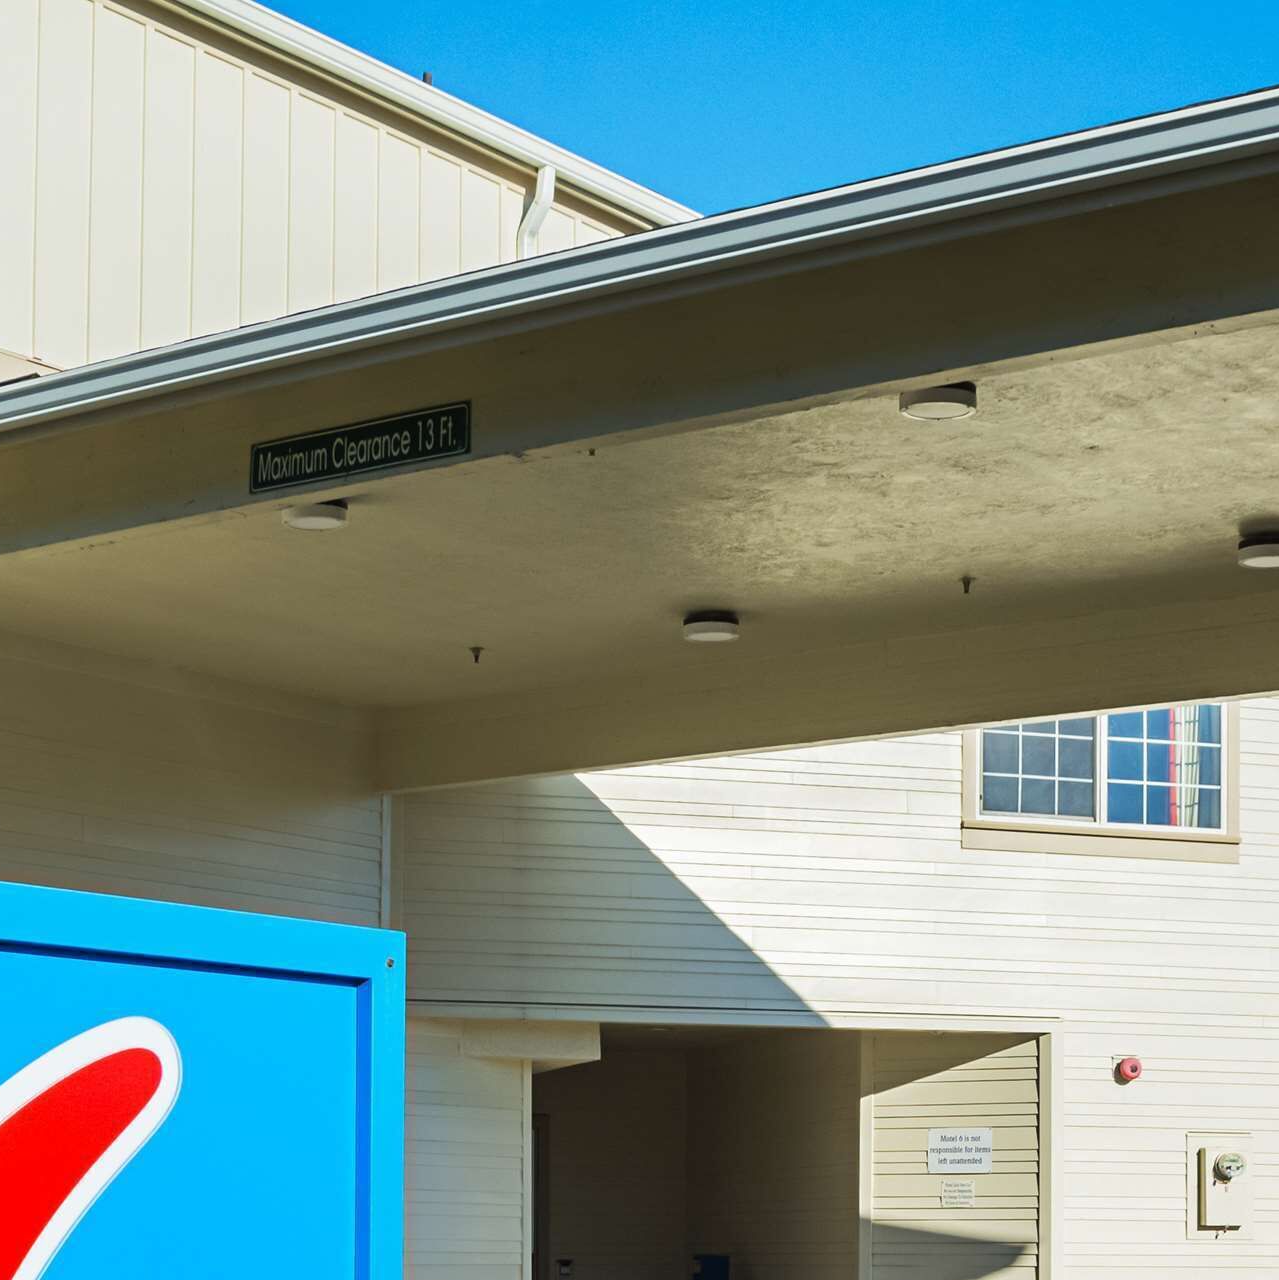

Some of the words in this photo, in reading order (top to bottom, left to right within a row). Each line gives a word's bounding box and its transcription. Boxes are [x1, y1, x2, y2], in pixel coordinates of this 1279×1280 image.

[258, 446, 328, 483] Maximum
[332, 429, 410, 470] Clearance
[417, 418, 434, 451] 13
[439, 415, 457, 449] Ft.
[970, 1135, 981, 1143] not
[929, 1146, 963, 1154] responsible
